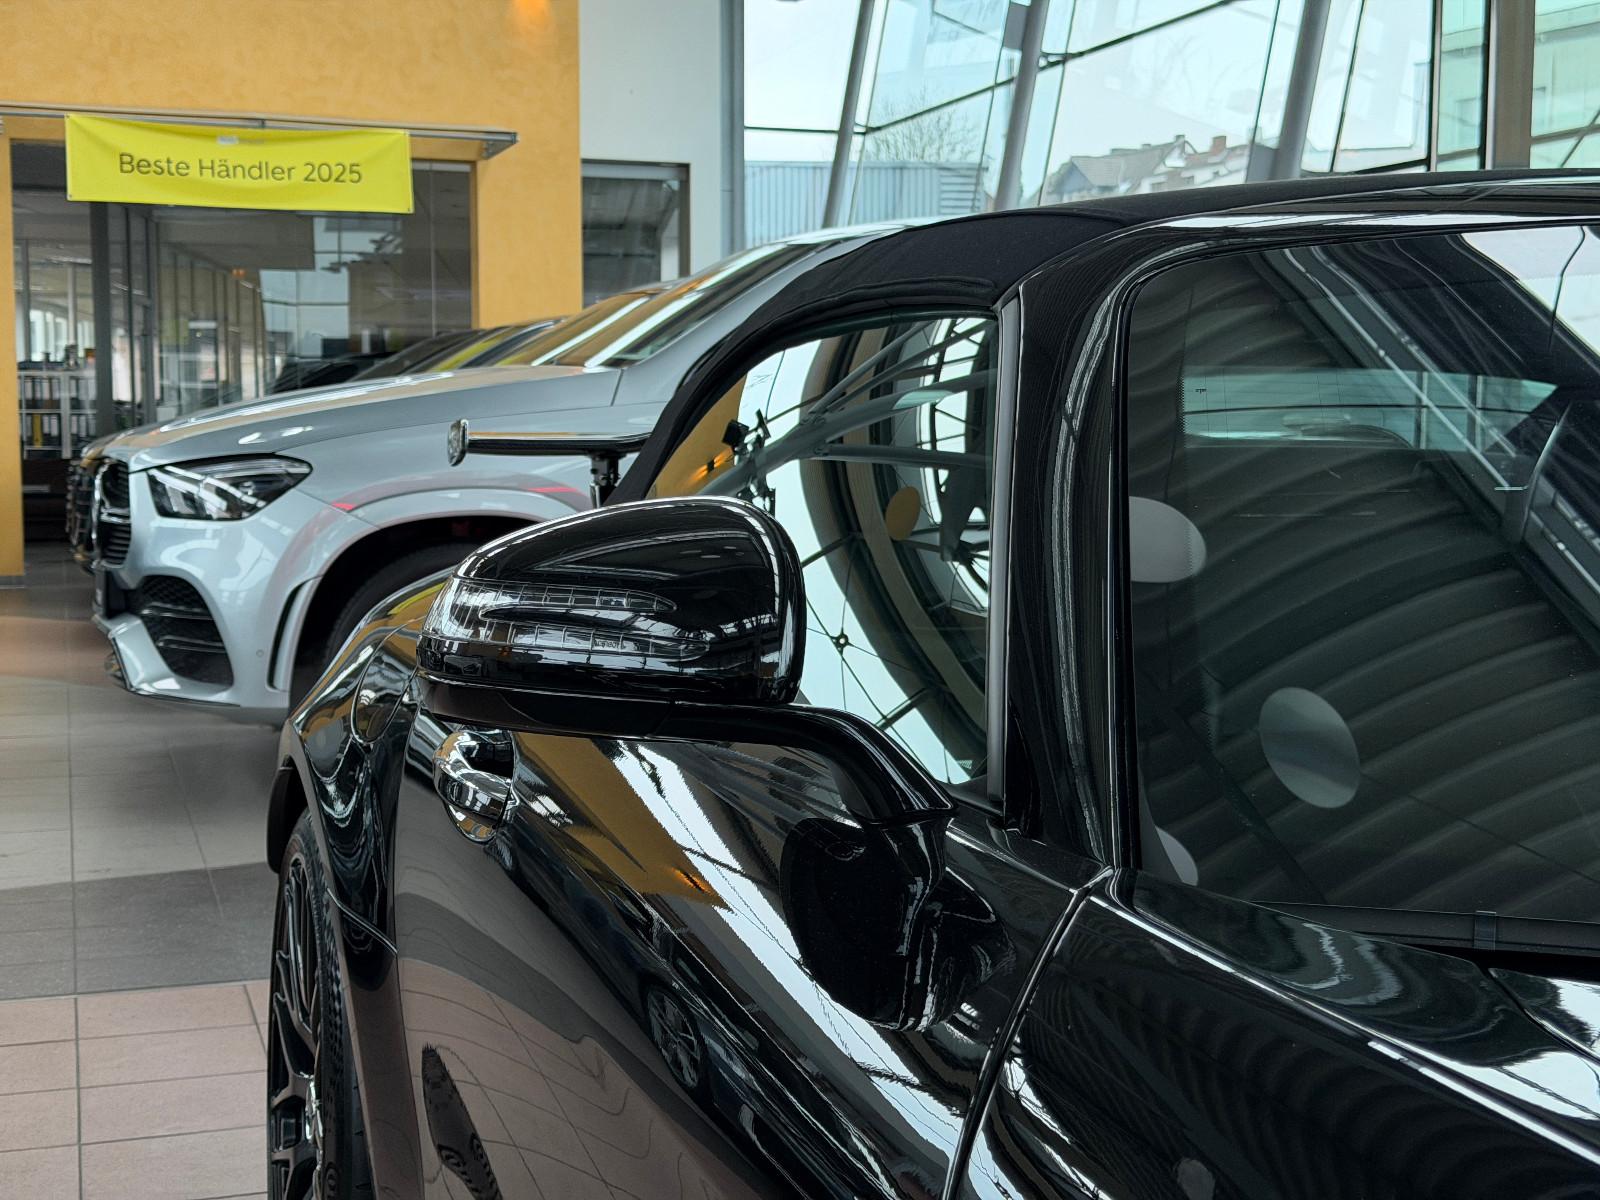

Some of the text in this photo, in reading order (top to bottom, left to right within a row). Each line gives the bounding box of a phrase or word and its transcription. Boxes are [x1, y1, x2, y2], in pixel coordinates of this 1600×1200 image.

[119, 152, 363, 184] Beste Händler 2025
